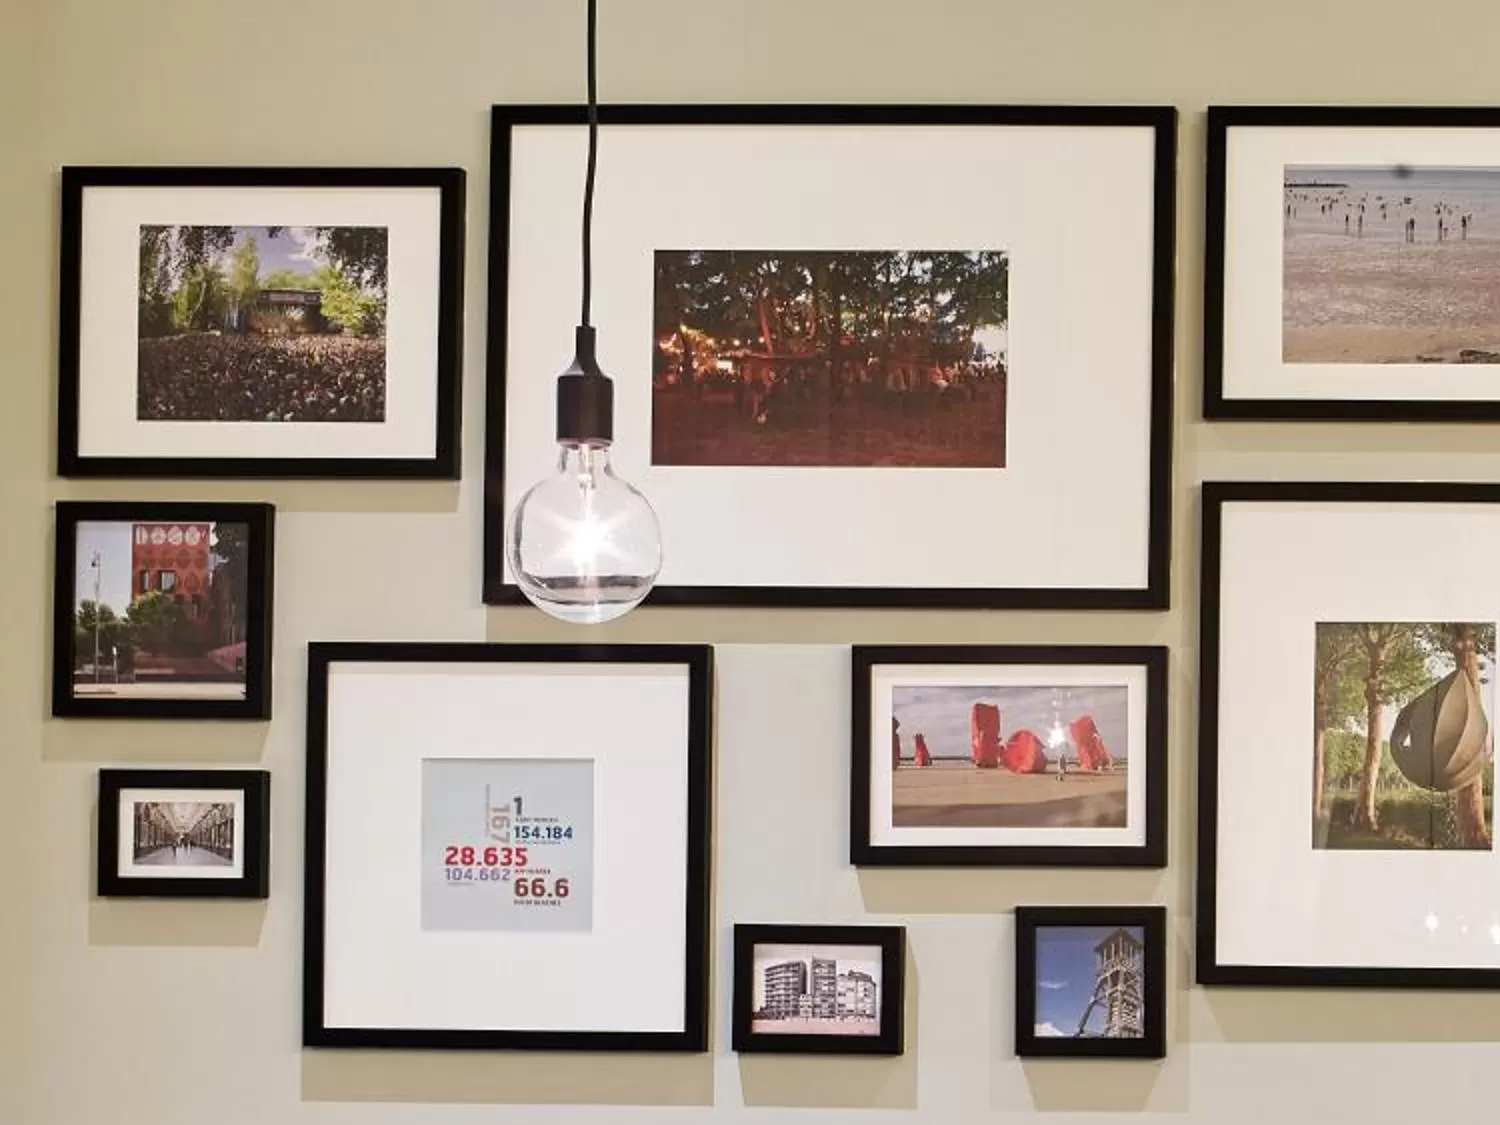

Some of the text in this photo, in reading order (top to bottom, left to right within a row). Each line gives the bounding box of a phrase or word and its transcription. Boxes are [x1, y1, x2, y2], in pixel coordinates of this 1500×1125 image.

[513, 796, 522, 816] 1
[491, 804, 511, 844] 167
[513, 825, 573, 839] 154.184
[445, 846, 528, 867] 28.635
[514, 877, 569, 898] 66.6
